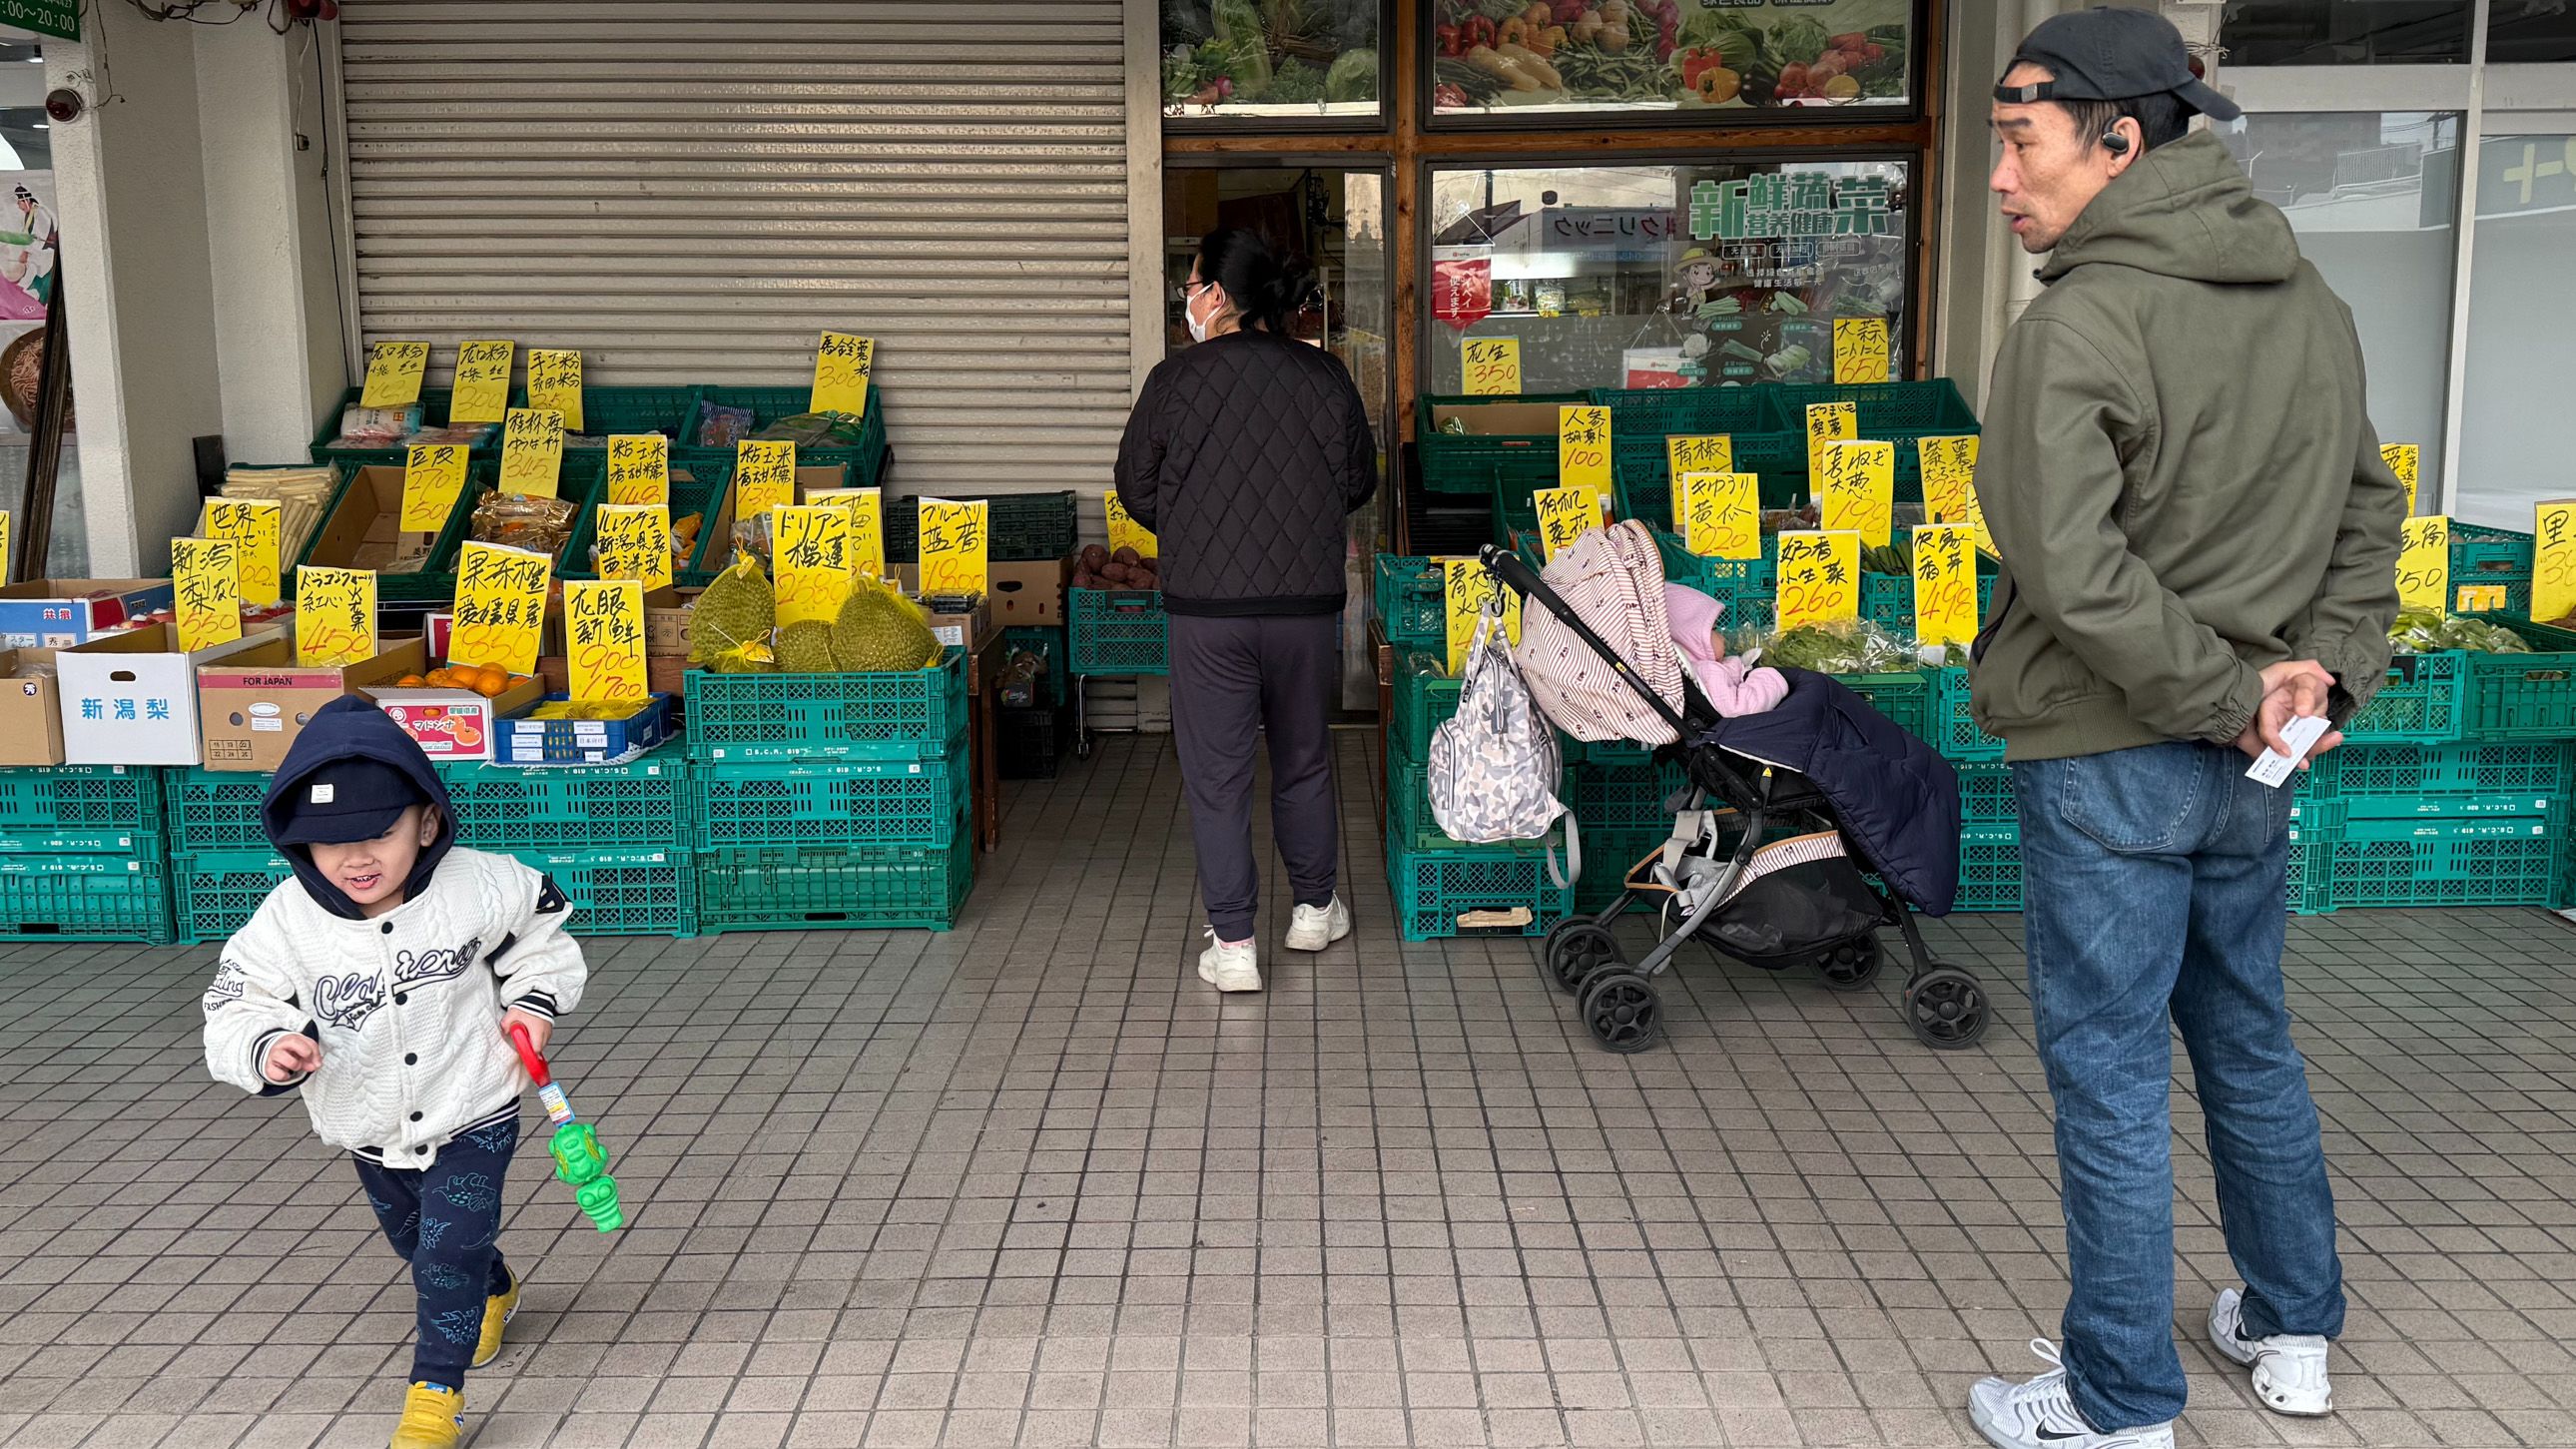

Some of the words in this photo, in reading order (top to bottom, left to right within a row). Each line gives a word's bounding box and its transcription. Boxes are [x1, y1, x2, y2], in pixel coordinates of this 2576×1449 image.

[819, 366, 862, 387] 300
[1474, 363, 1516, 383] 350
[1840, 356, 1888, 383] 650
[1565, 448, 1604, 469] 100
[408, 467, 450, 500] 270
[1831, 499, 1888, 535] 198
[1697, 526, 1749, 556] 220
[1785, 582, 1843, 616] 260
[1920, 580, 1972, 624] 498
[182, 610, 238, 634] 550
[303, 618, 371, 655] 450
[462, 623, 536, 662] 850
[579, 644, 640, 678] 900
[581, 674, 642, 699] 1700
[81, 698, 170, 720] 新潟梨
